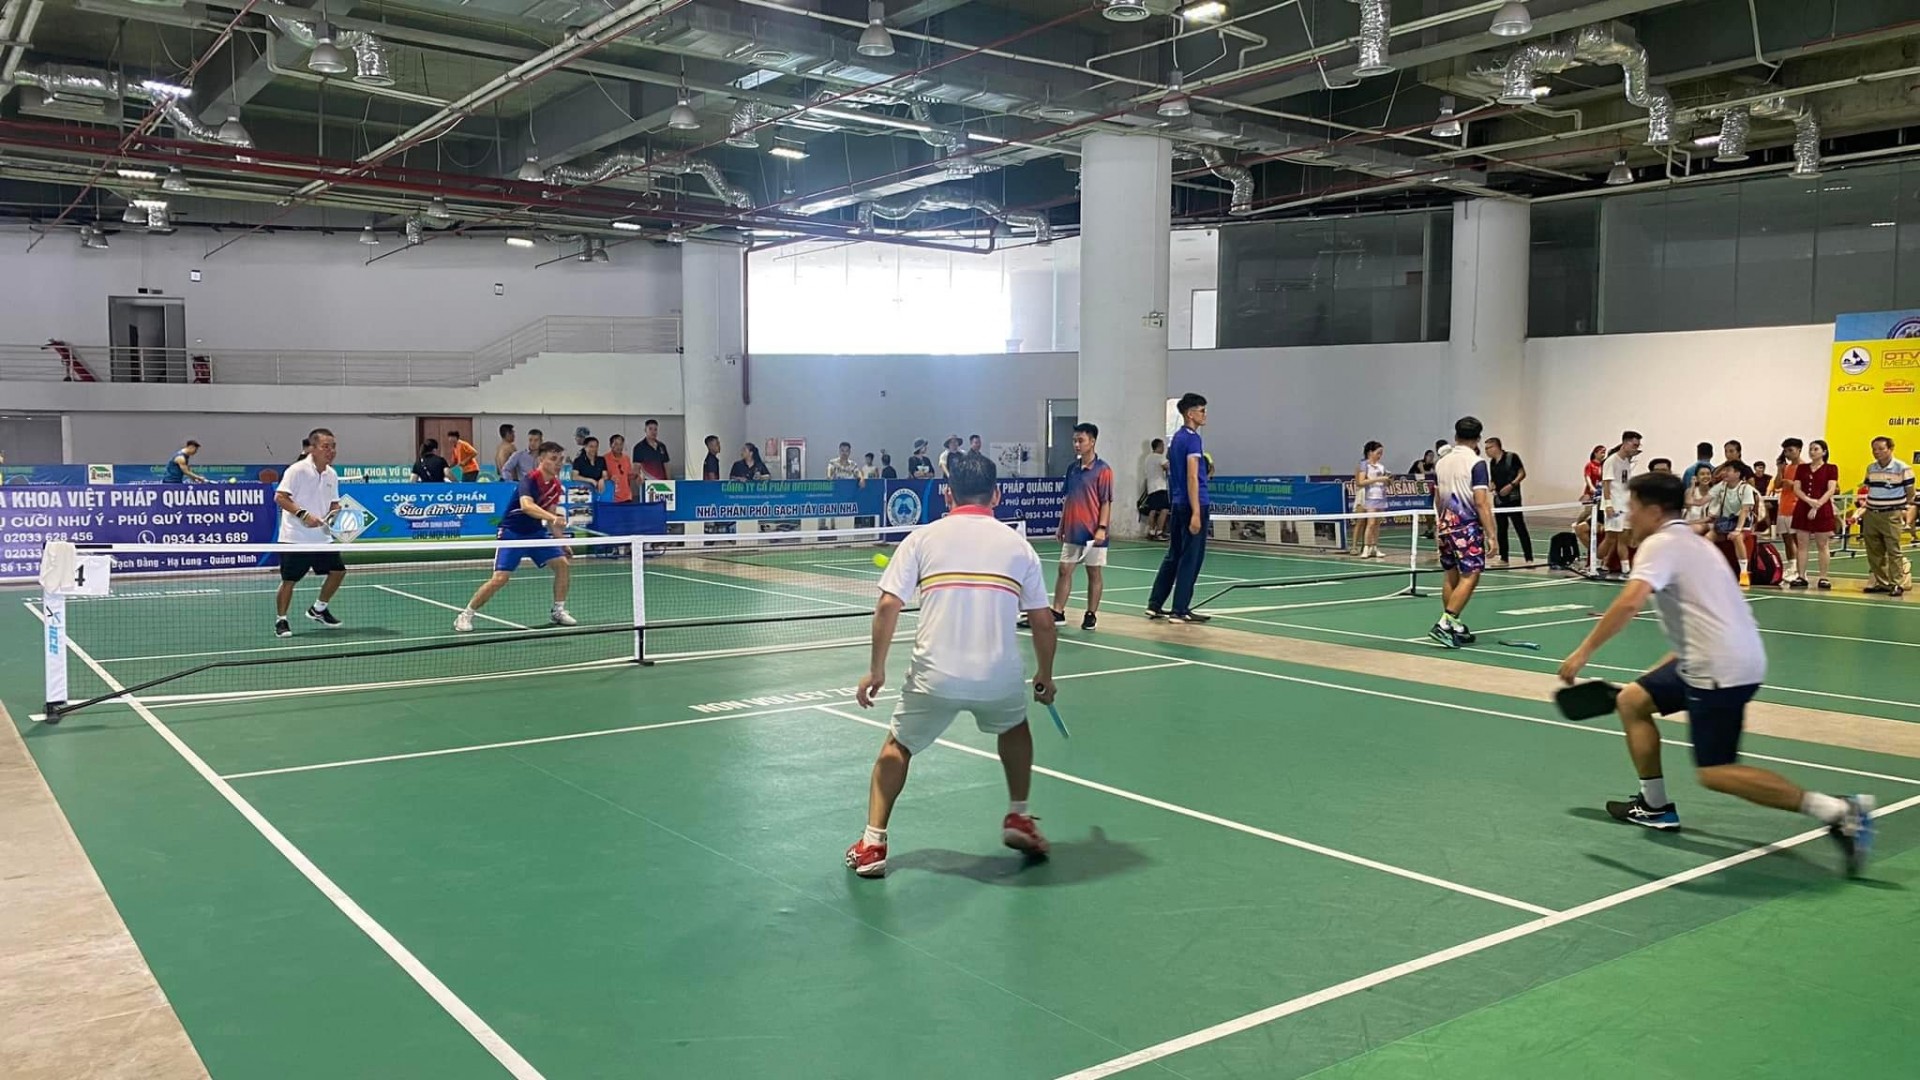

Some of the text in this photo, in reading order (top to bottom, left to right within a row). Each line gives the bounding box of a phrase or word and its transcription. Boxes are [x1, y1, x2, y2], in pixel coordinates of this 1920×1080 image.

[364, 467, 387, 477] KHOA
[1002, 480, 1025, 494] PHÁP
[1026, 479, 1054, 494] QUẢNG
[12, 491, 63, 508] KHOA
[67, 487, 106, 511] VIỆT
[111, 487, 157, 508] PHÁP
[162, 485, 219, 508] QUẢNG
[224, 489, 264, 506] NINH
[383, 493, 417, 502] CÔNG
[420, 494, 434, 502] TY
[819, 503, 837, 515] BAN
[11, 513, 53, 528] CƯỜI
[58, 514, 92, 527] NHƯ
[95, 512, 105, 526] Ý
[118, 511, 148, 526] PHÚ
[152, 511, 184, 525] QUÝ
[187, 513, 224, 528] TRỌN
[228, 509, 254, 525] ĐỜI
[4, 531, 93, 543] 02033 628 456
[162, 532, 249, 543] 0934 343 689
[742, 690, 833, 706] VOLLEY
